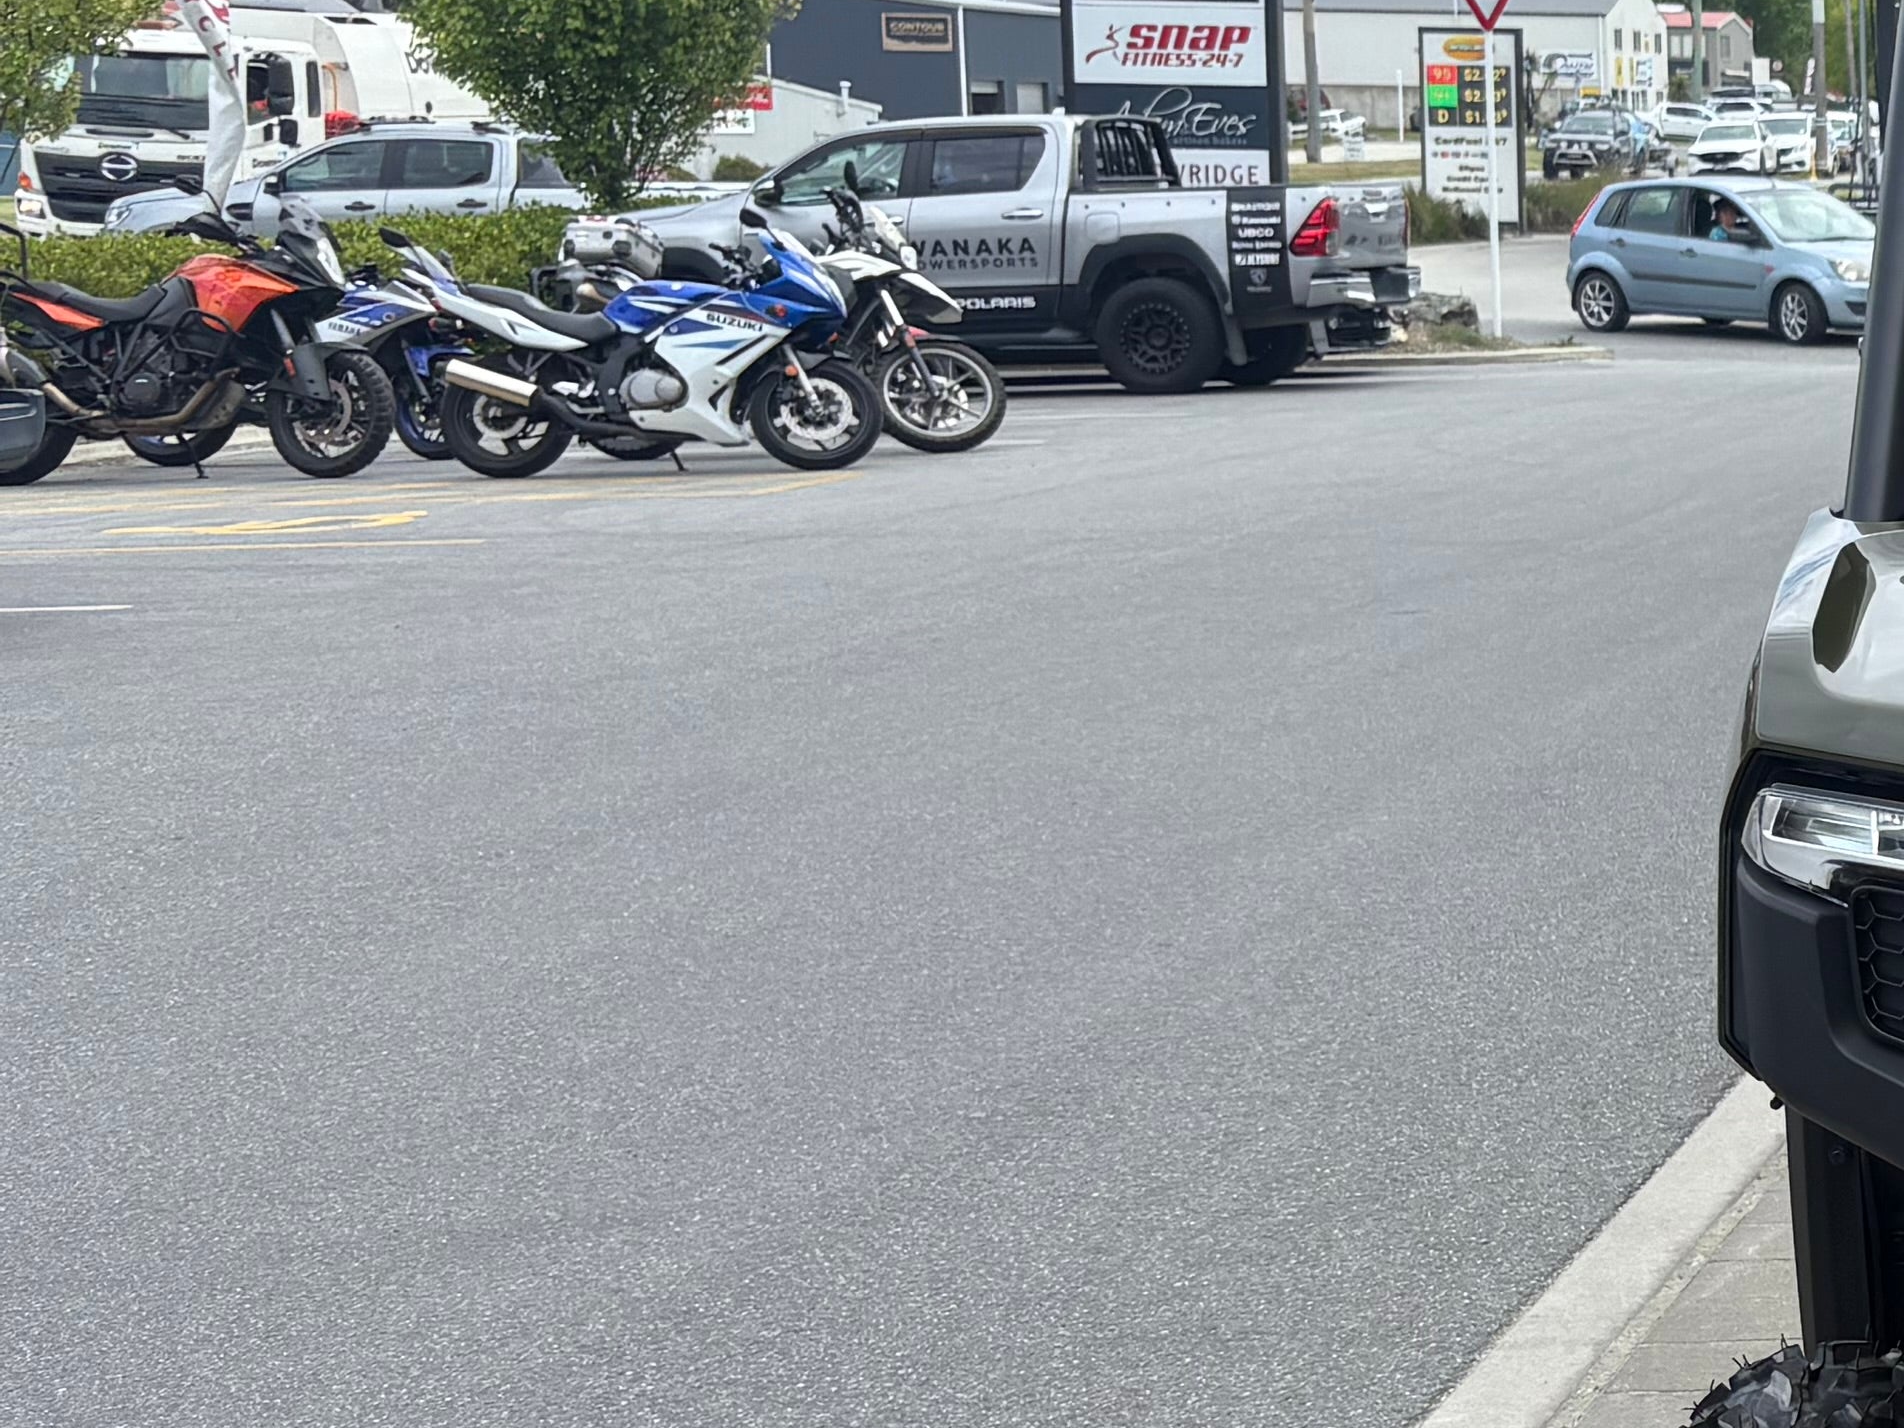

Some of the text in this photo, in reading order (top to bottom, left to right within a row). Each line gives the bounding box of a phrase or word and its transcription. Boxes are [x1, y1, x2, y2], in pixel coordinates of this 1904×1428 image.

[1438, 110, 1449, 123] D
[917, 257, 1038, 270] OWERSPORTS
[706, 313, 763, 332] SUZUKI
